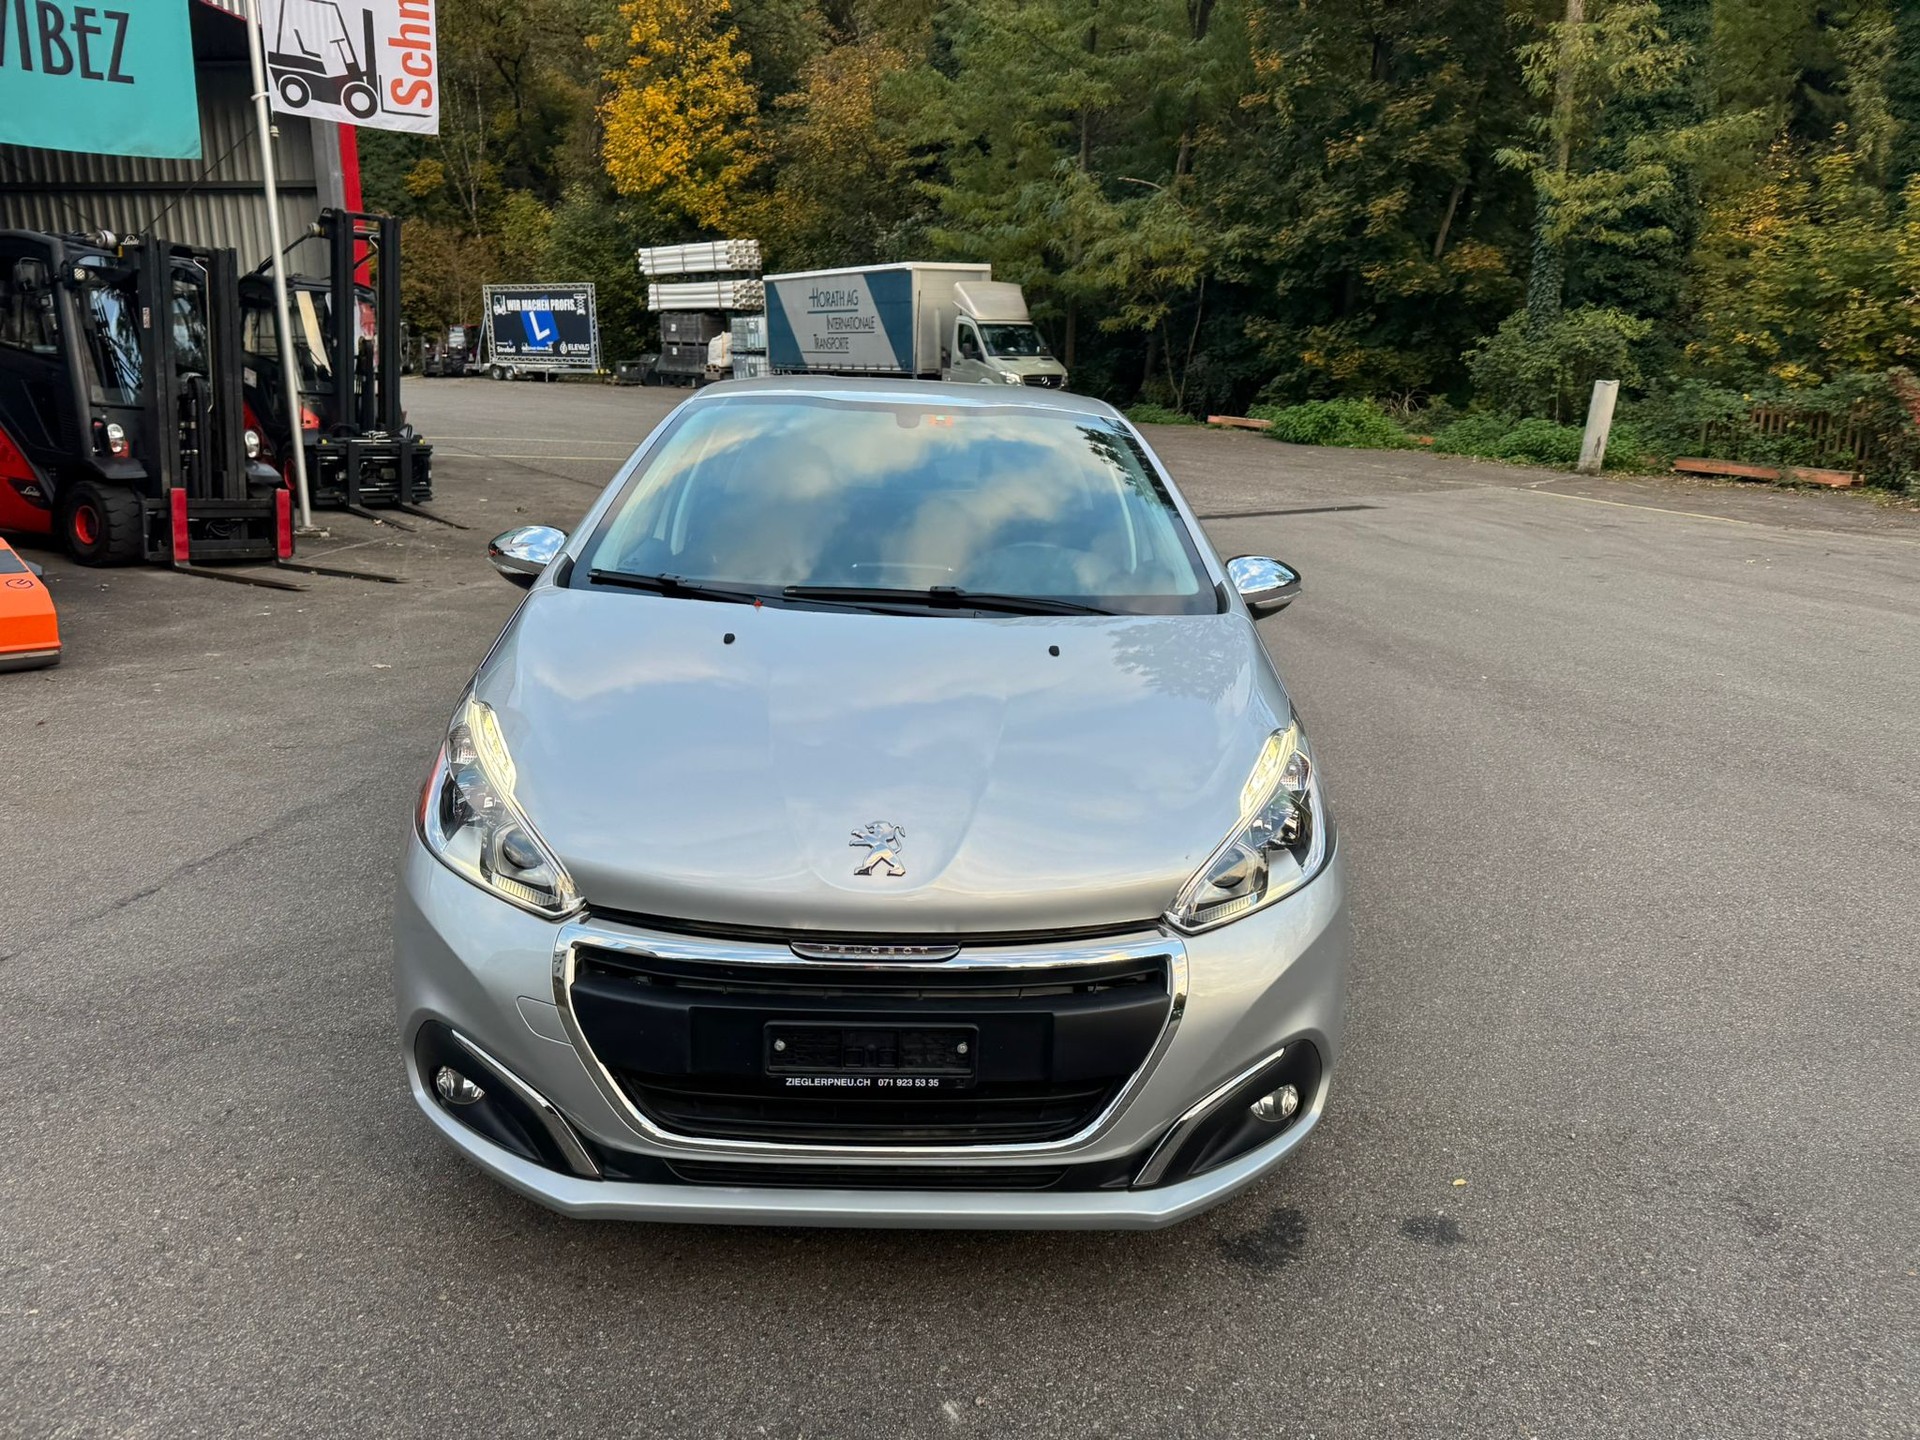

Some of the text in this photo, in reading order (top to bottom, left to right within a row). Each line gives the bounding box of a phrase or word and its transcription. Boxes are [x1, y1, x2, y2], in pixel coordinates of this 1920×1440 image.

[0, 0, 135, 84] IBEZ
[521, 299, 549, 311] MACHEN
[809, 288, 859, 307] HORATH AG
[528, 311, 551, 341] L
[827, 314, 875, 331] INTERNATIONALE
[813, 333, 849, 350] TRANSPORTE
[785, 1077, 940, 1087] ZIEGLERPNEU.CH 071 923 53 35
